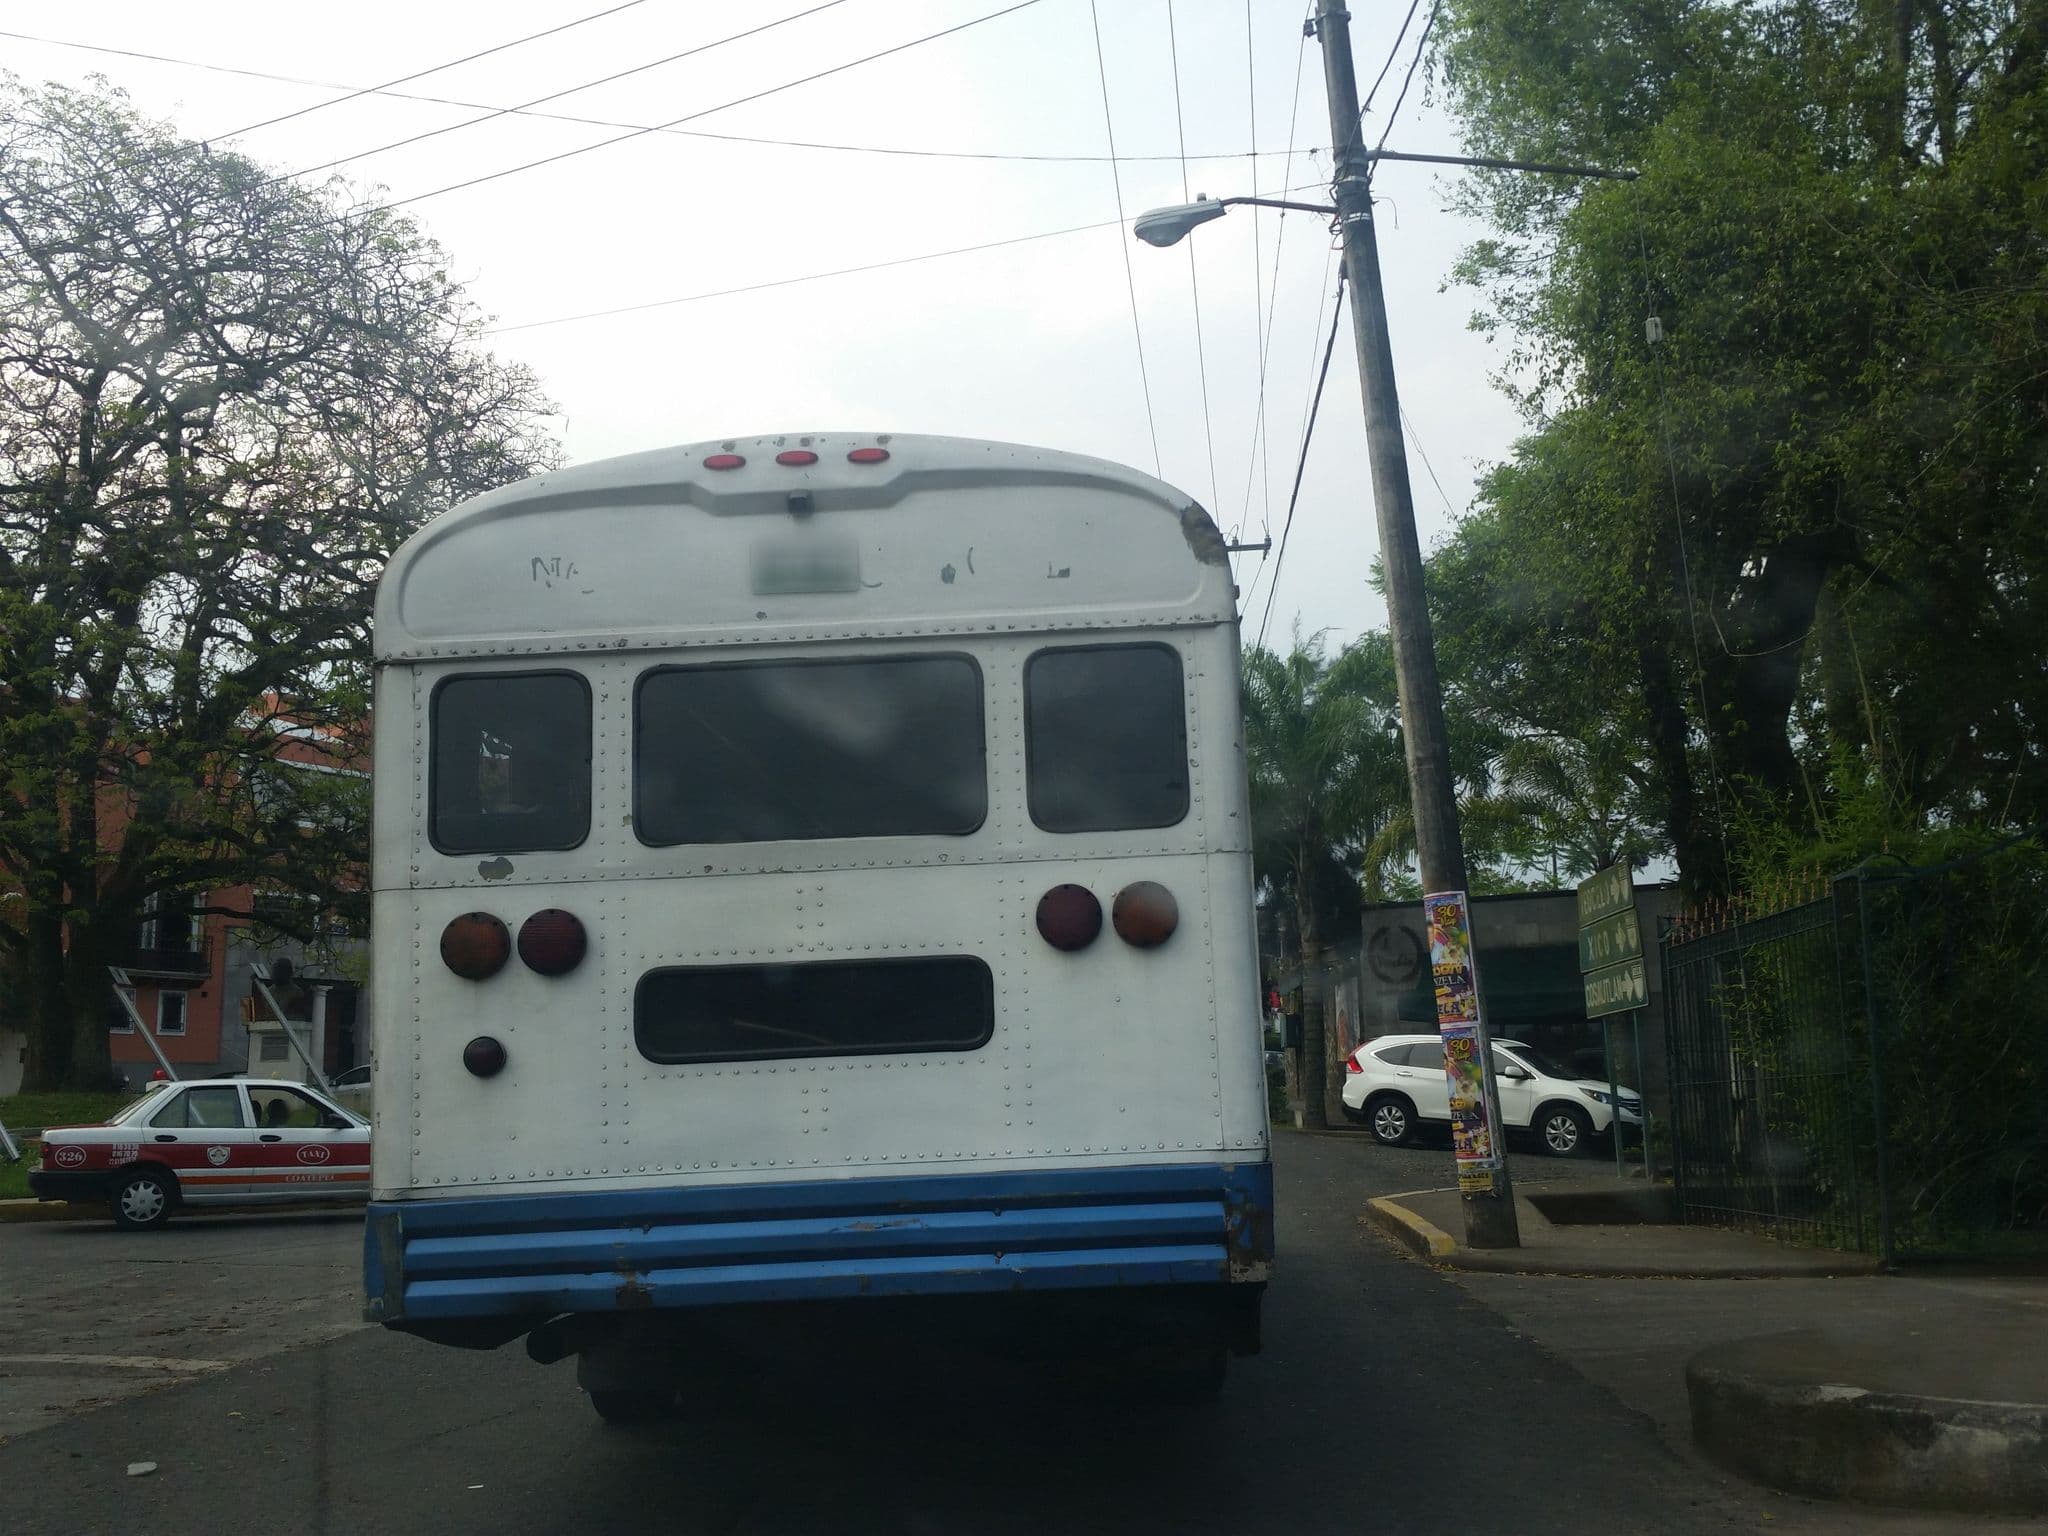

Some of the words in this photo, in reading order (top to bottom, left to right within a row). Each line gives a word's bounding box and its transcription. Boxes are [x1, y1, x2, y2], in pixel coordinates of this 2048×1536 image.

[1588, 930, 1609, 961] XICO
[58, 1151, 83, 1162] 326
[300, 1149, 325, 1159] TAXI
